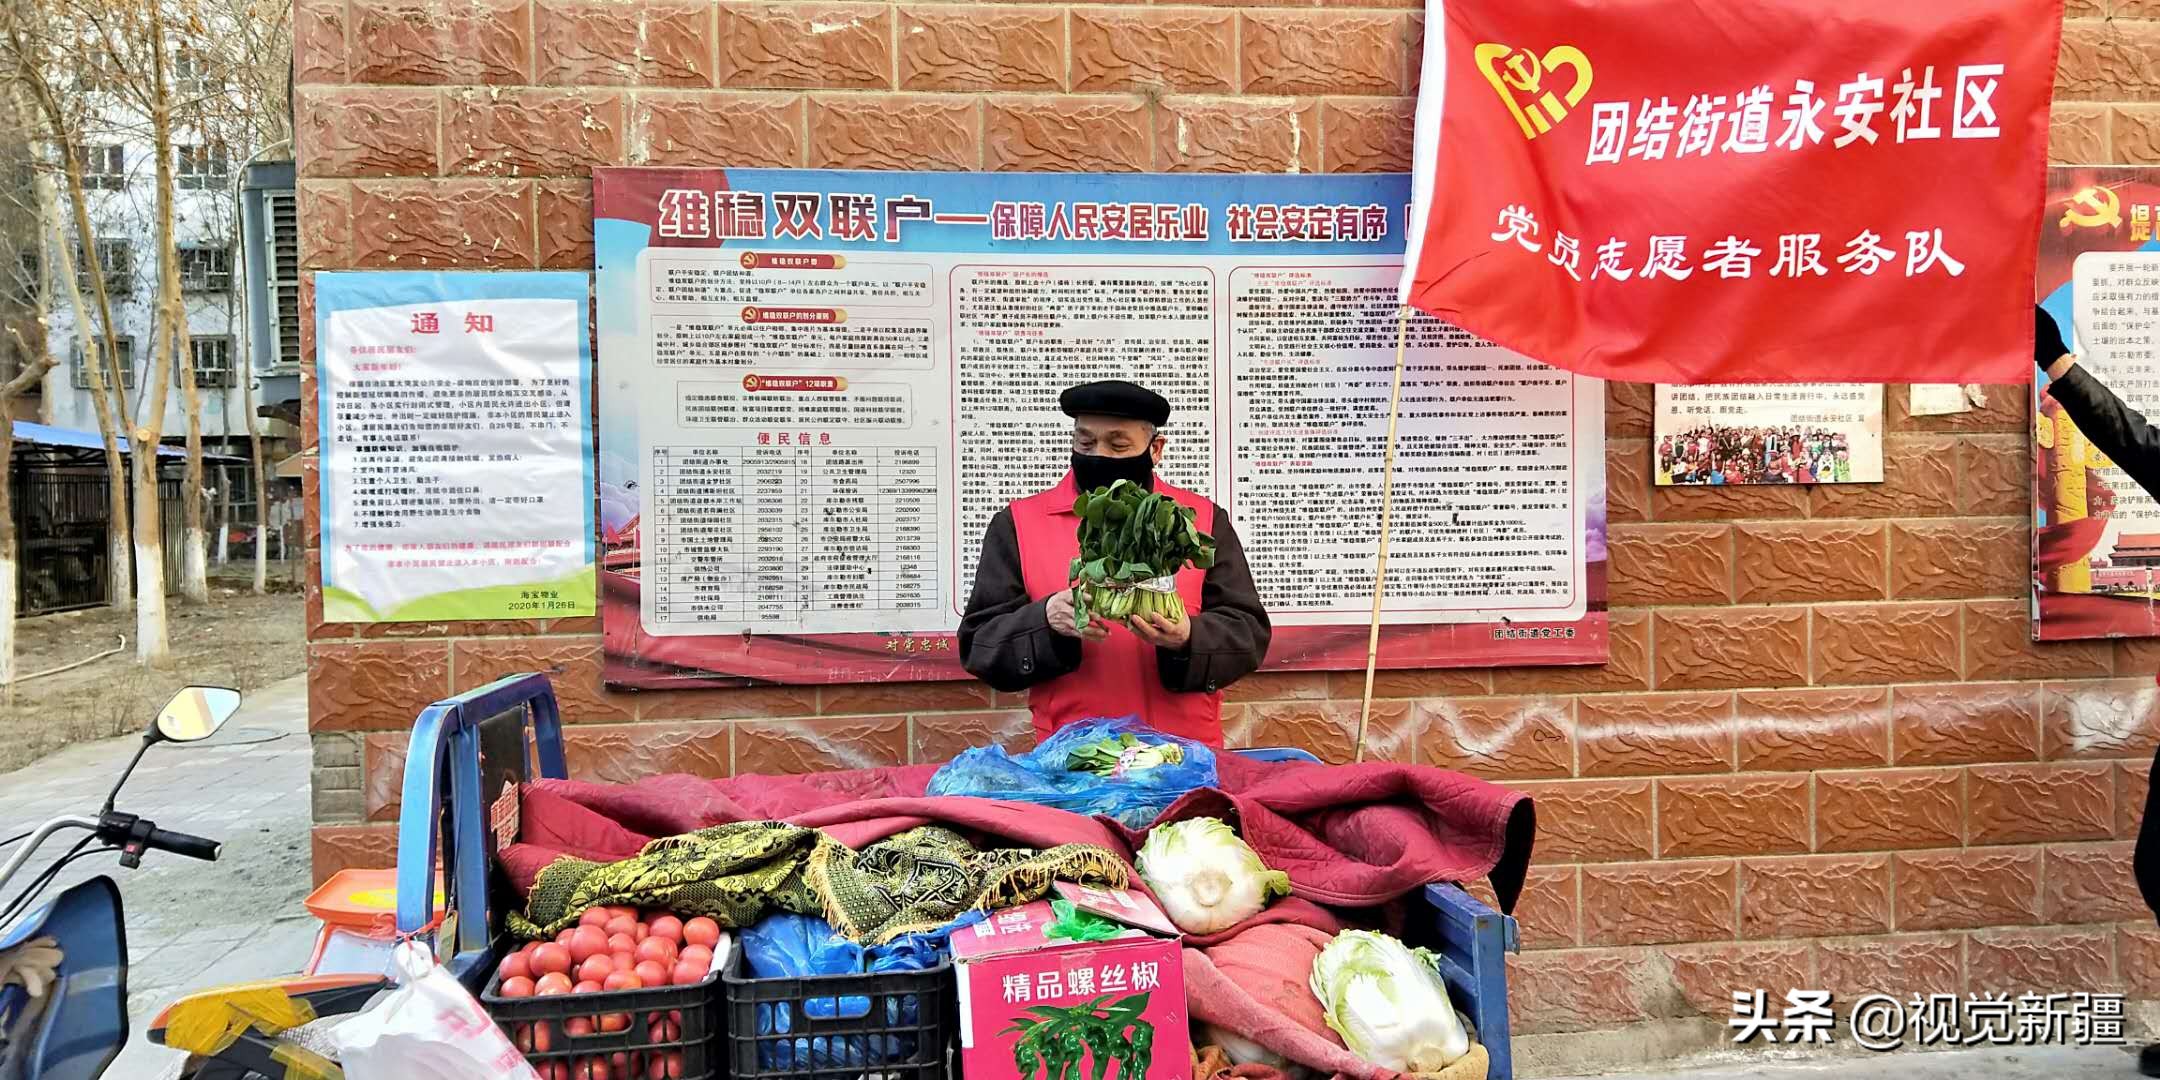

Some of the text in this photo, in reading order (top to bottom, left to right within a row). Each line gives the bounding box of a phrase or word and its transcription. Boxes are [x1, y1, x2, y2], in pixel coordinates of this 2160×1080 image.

[1585, 64, 2006, 166] 团结街道永安社区
[1227, 203, 1388, 242] 社会安定有序
[2130, 203, 2160, 241] 提
[1491, 204, 1966, 281] 党员志愿者服务队
[757, 432, 832, 447] 便民信息
[884, 637, 951, 653] 对党忠诚
[1493, 627, 1576, 641] 团结街道党工委
[1002, 961, 1161, 1005] 精品螺丝椒
